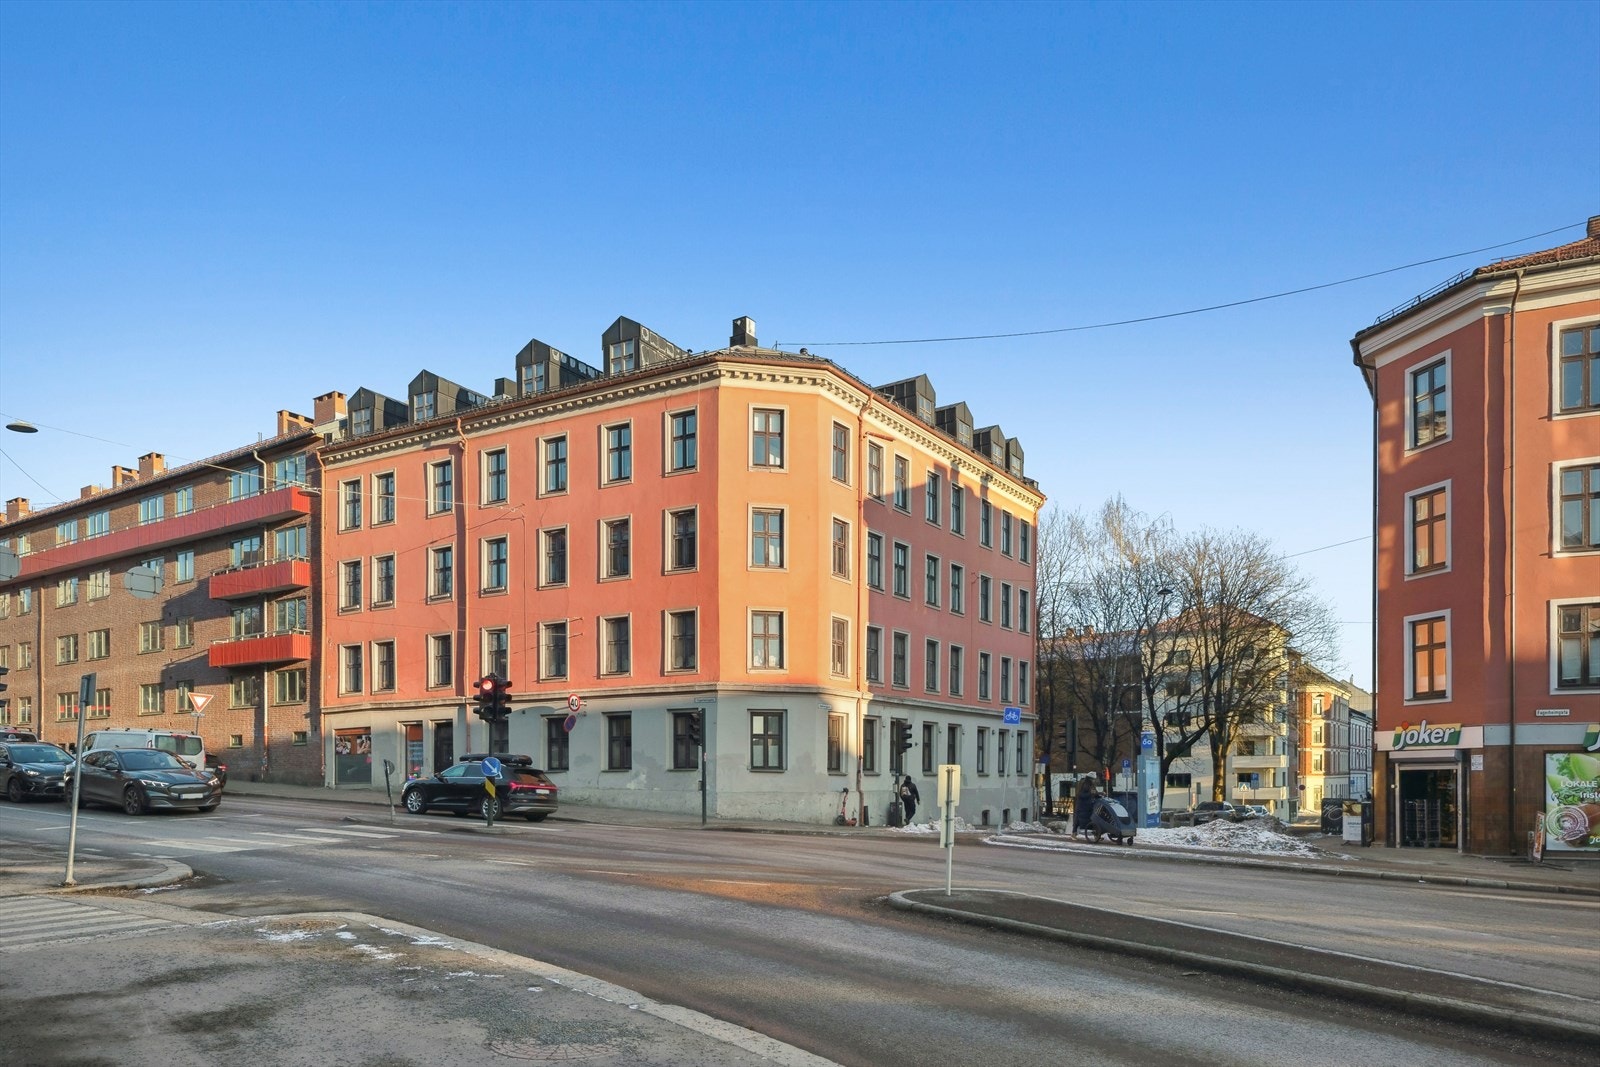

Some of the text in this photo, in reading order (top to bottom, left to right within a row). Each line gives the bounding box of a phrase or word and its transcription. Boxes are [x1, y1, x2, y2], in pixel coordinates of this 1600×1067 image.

[571, 698, 578, 708] 40
[1394, 719, 1455, 751] joker
[1560, 780, 1598, 788] LOKALE
